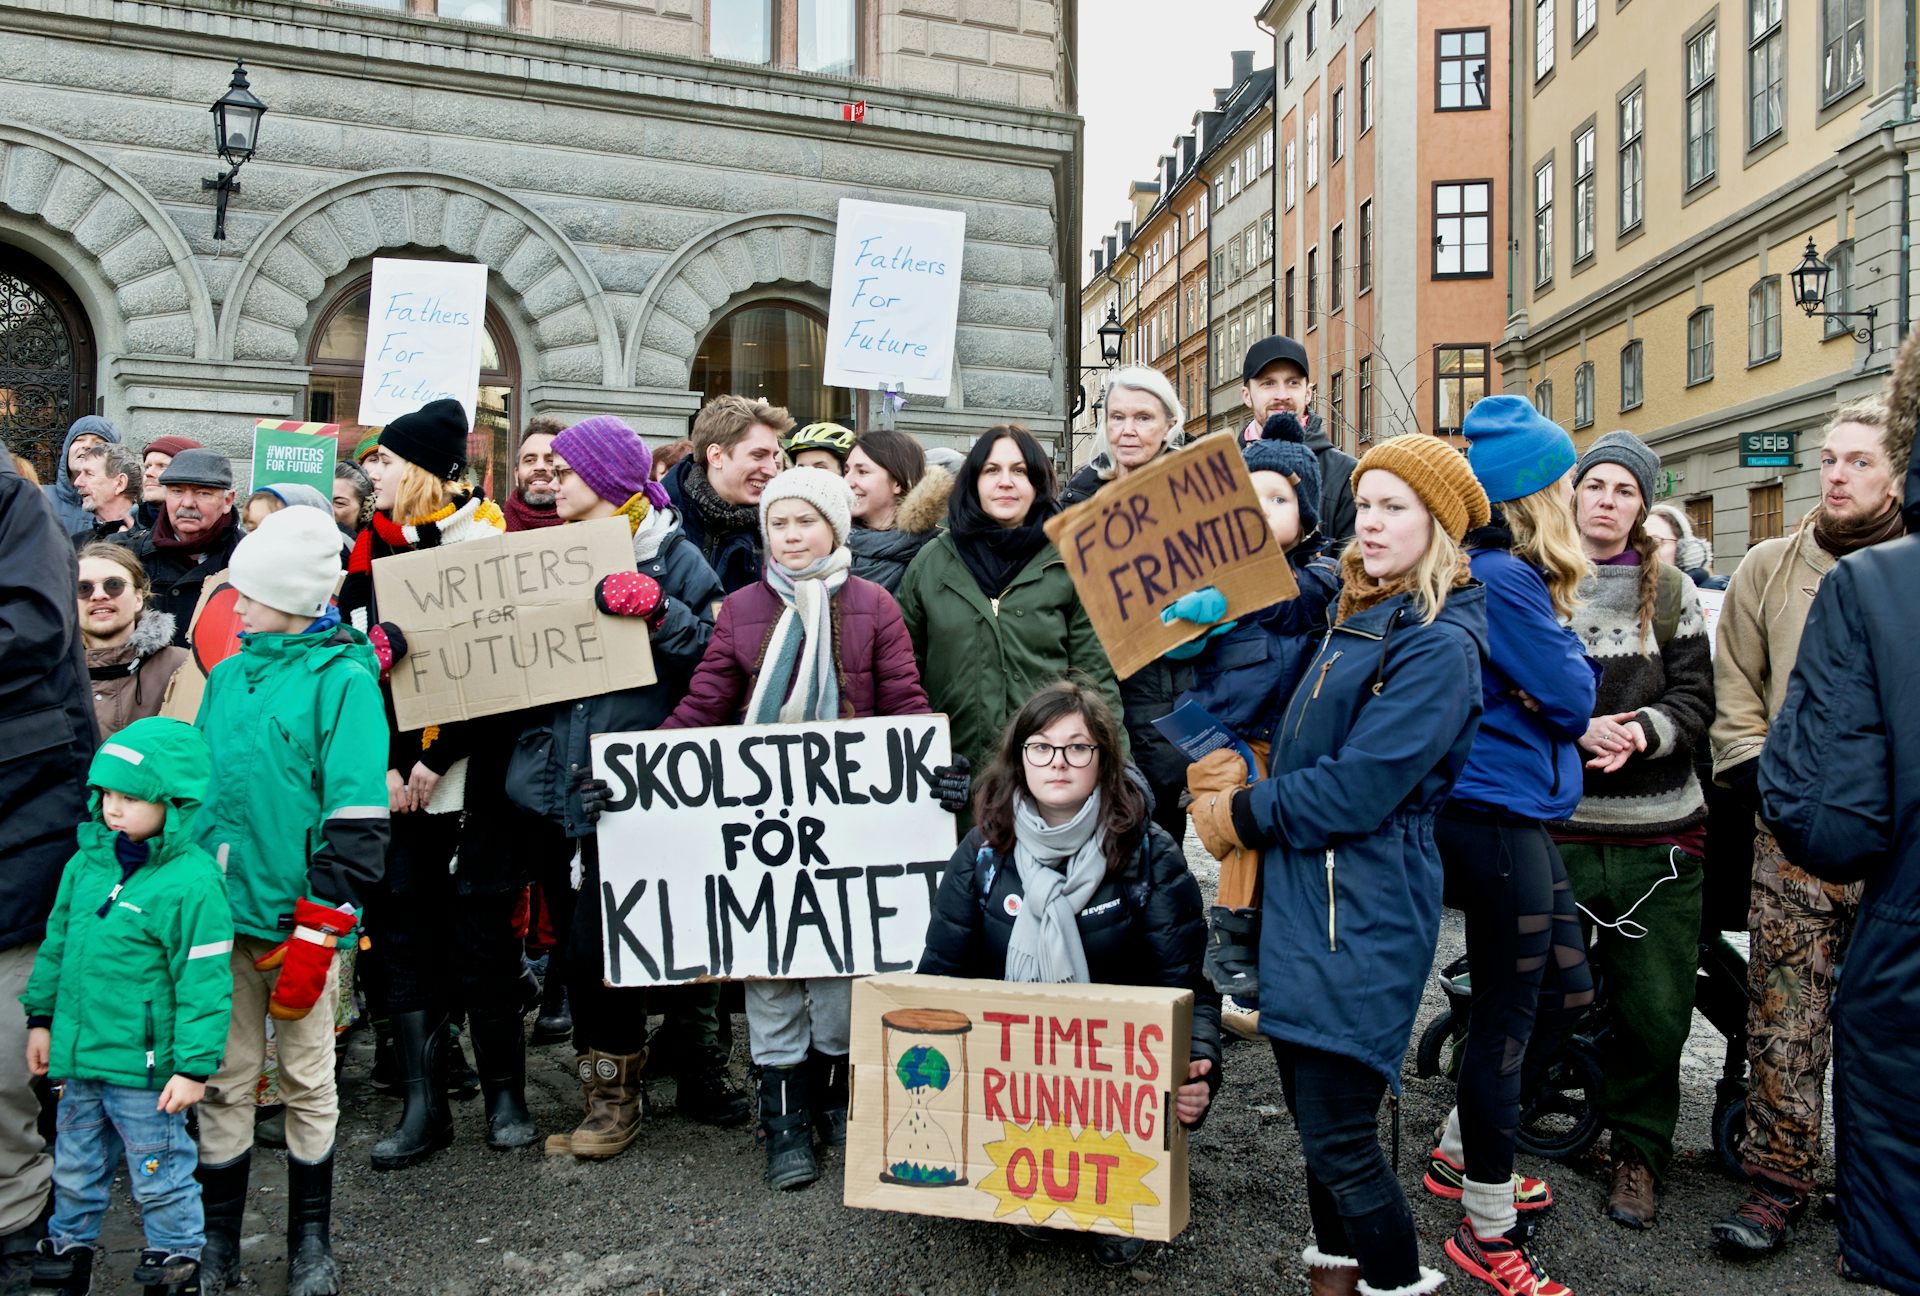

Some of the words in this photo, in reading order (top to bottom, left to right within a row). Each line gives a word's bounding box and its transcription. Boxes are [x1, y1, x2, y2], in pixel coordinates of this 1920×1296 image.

[855, 236, 945, 276] Fathers
[385, 292, 470, 325] Fathers
[851, 277, 902, 308] For
[378, 332, 424, 364] For
[844, 319, 928, 358] Future
[266, 445, 325, 462] #WRITERS
[266, 459, 285, 472] FOR
[287, 460, 324, 474] FUTURE
[1748, 435, 1790, 451] SEB
[1075, 494, 1158, 575] FÖR
[1168, 451, 1238, 514] MIN
[404, 546, 594, 612] WRITERS
[1108, 506, 1268, 622] FRAMTID
[472, 605, 516, 629] FOR
[410, 622, 603, 693] FUTURE
[604, 726, 937, 812] SKOLSTREJK
[721, 808, 830, 871] FÖR
[983, 1011, 1112, 1072] TIME
[1124, 1022, 1164, 1081] IS
[983, 1067, 1158, 1141] RUNNING
[1006, 1147, 1120, 1205] OUT
